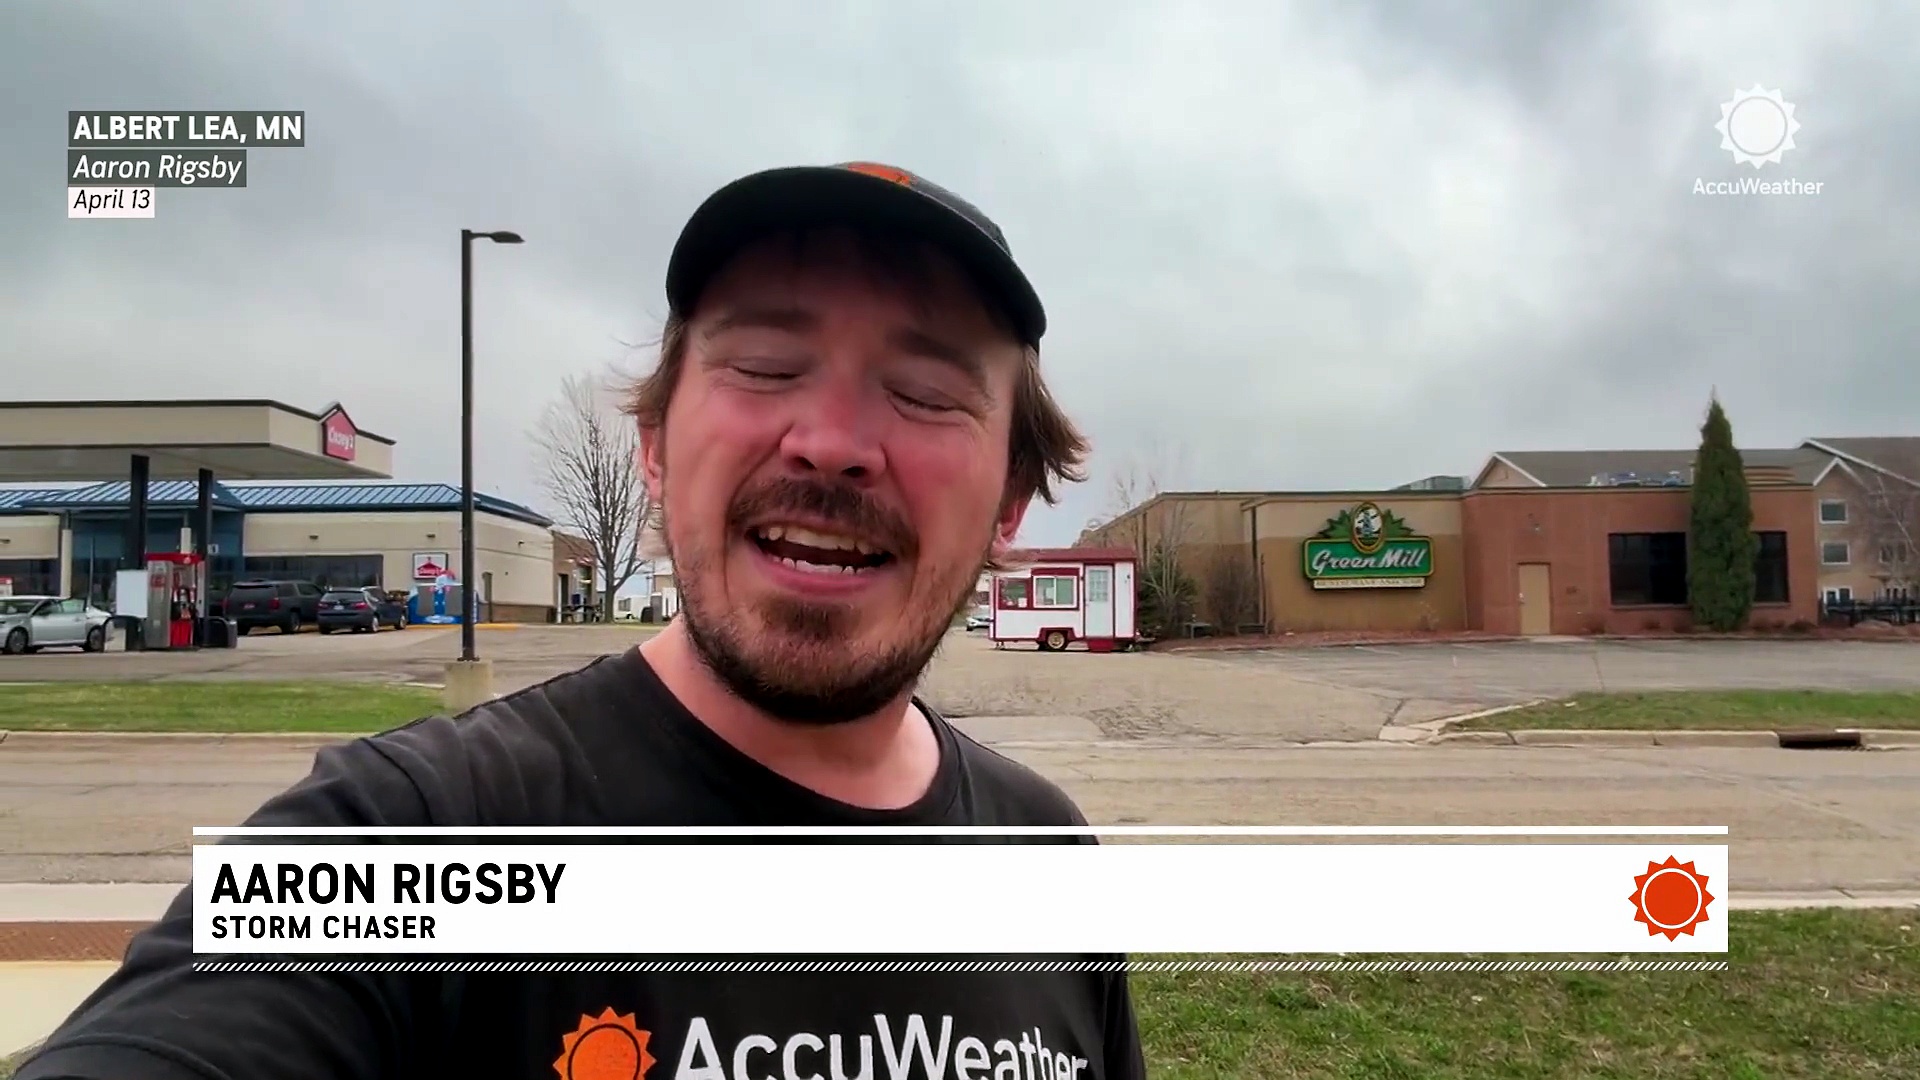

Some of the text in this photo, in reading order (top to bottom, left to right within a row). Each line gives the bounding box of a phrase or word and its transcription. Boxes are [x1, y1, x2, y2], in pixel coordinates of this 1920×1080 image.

[1312, 548, 1427, 576] Green Mill
[674, 1013, 1088, 1080] AccuWeather
